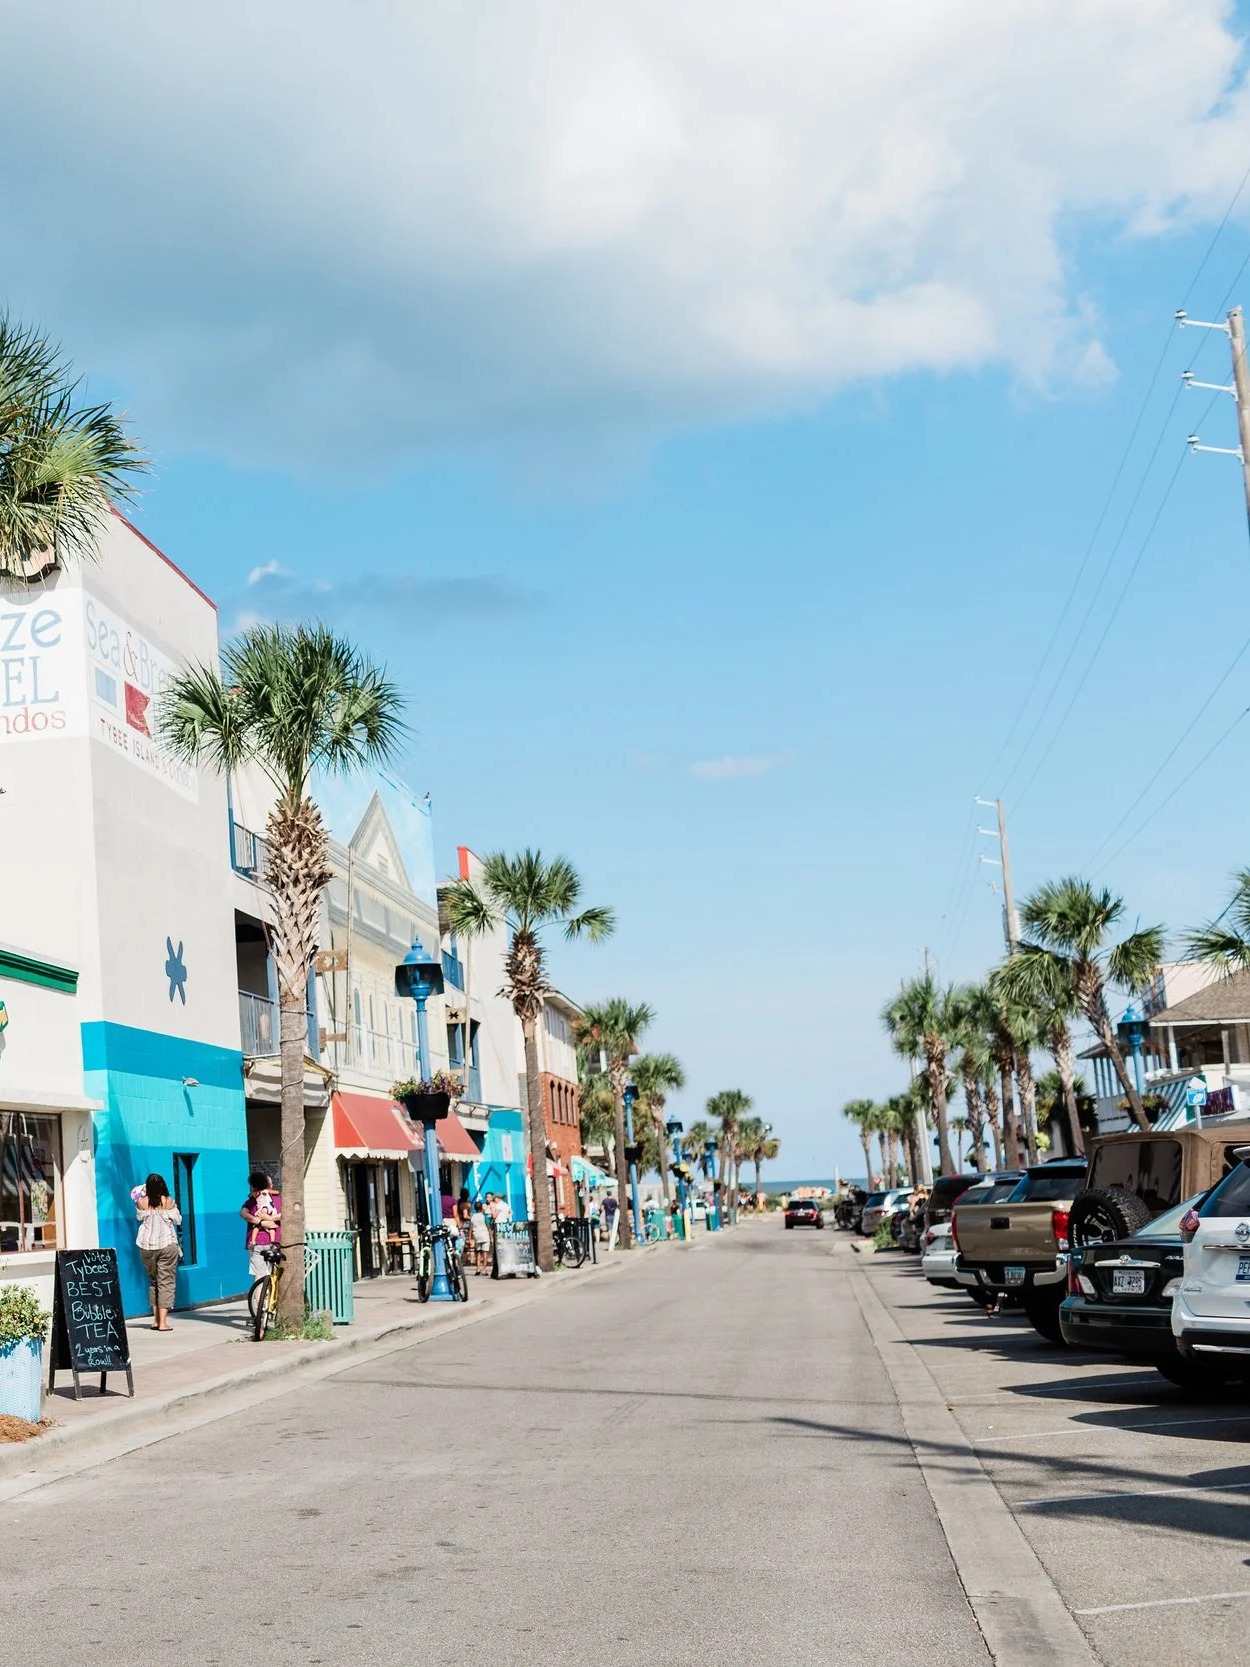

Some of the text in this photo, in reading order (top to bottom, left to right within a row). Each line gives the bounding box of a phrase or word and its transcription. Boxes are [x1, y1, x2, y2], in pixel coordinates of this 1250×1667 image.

[86, 601, 121, 668] Sea
[100, 718, 129, 751] TYBEE
[84, 1250, 111, 1263] Voted
[66, 1280, 113, 1297] BEST
[71, 1300, 112, 1321] Bubble
[75, 1321, 119, 1341] TEA
[75, 1343, 85, 1357] 2
[85, 1345, 103, 1358] years
